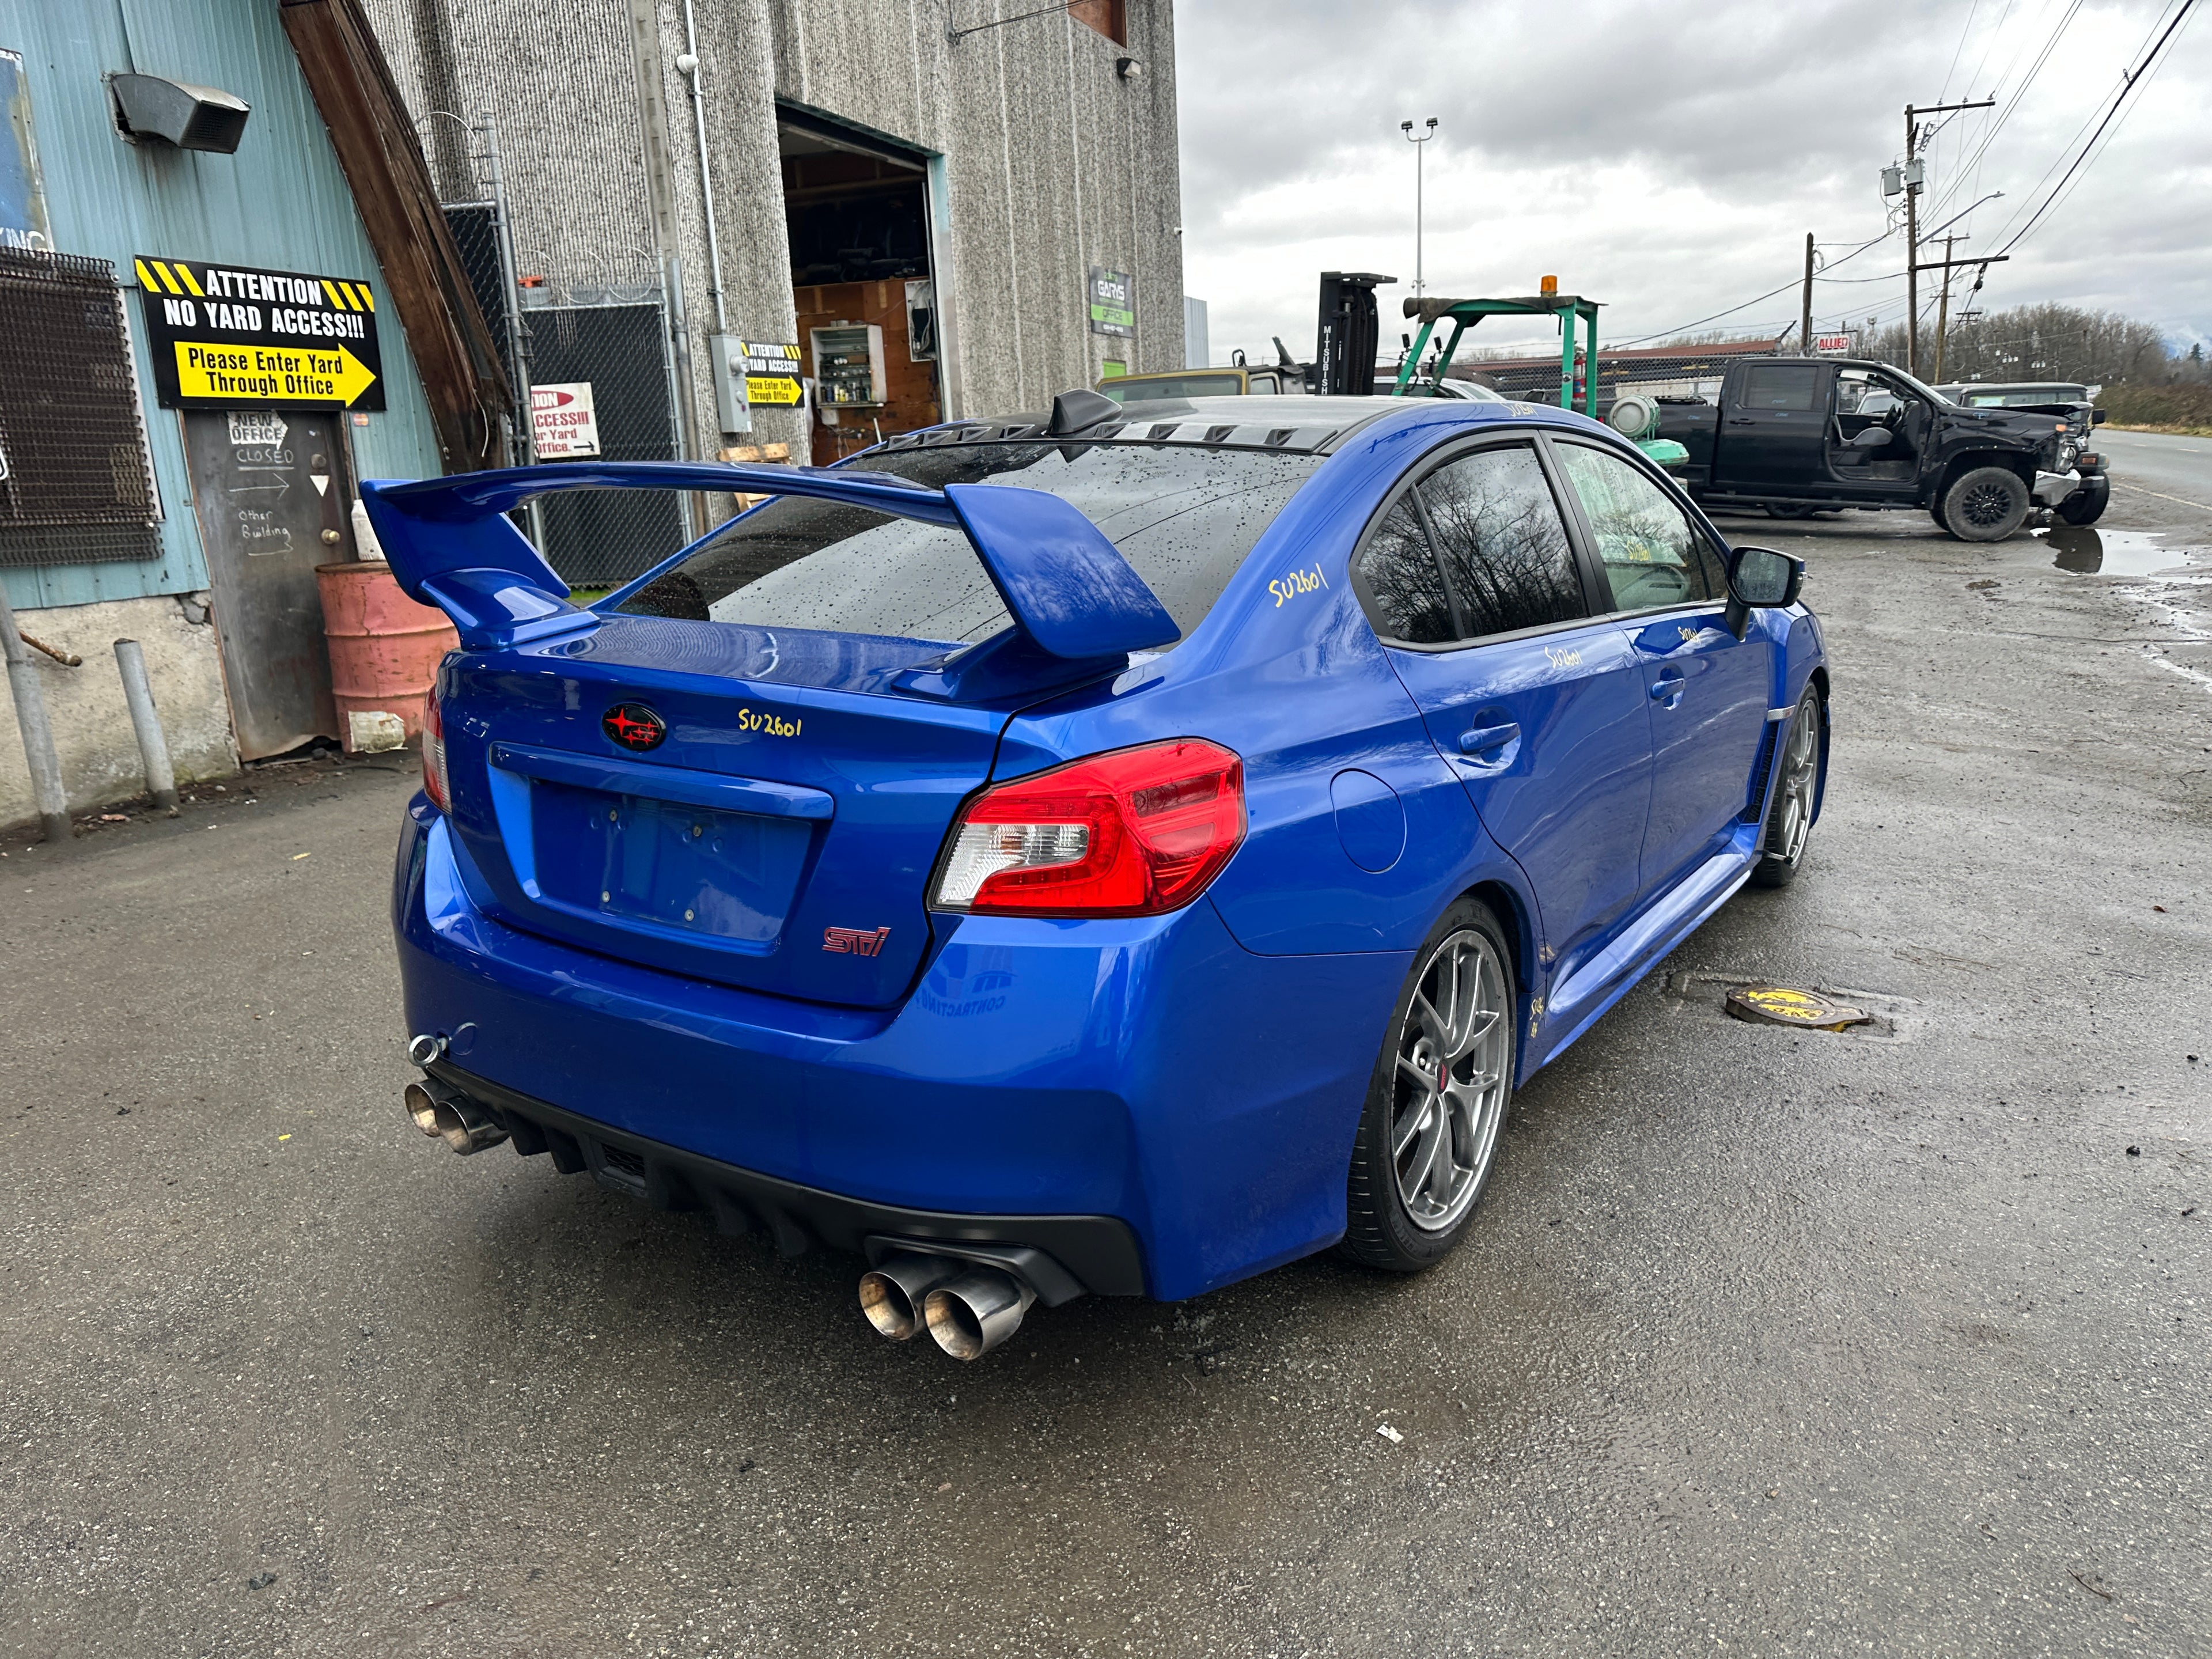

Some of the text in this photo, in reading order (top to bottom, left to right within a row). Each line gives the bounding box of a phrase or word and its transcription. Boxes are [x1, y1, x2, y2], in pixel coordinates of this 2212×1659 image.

[207, 270, 323, 305] ATTENTION
[1097, 280, 1125, 301] GARYS
[163, 298, 365, 339] NO YARD ACCESS!!!
[749, 343, 785, 358] ATTENTION
[1819, 338, 1848, 348] ALLIED
[188, 347, 343, 374] Please Enter Yard
[749, 358, 798, 373] YARD ACCESS!!!
[206, 372, 334, 396] Through Office
[764, 380, 778, 390] Enter
[780, 381, 791, 390] Yard
[751, 391, 789, 402] Through Office
[237, 414, 272, 426] NEW
[232, 426, 283, 441] OFFICE
[550, 428, 577, 440] Yard
[236, 449, 294, 463] CLOSED
[242, 524, 291, 541] Building
[1268, 563, 1330, 608] SU2601
[1544, 646, 1583, 669] SU2601
[738, 708, 802, 737] SU2601
